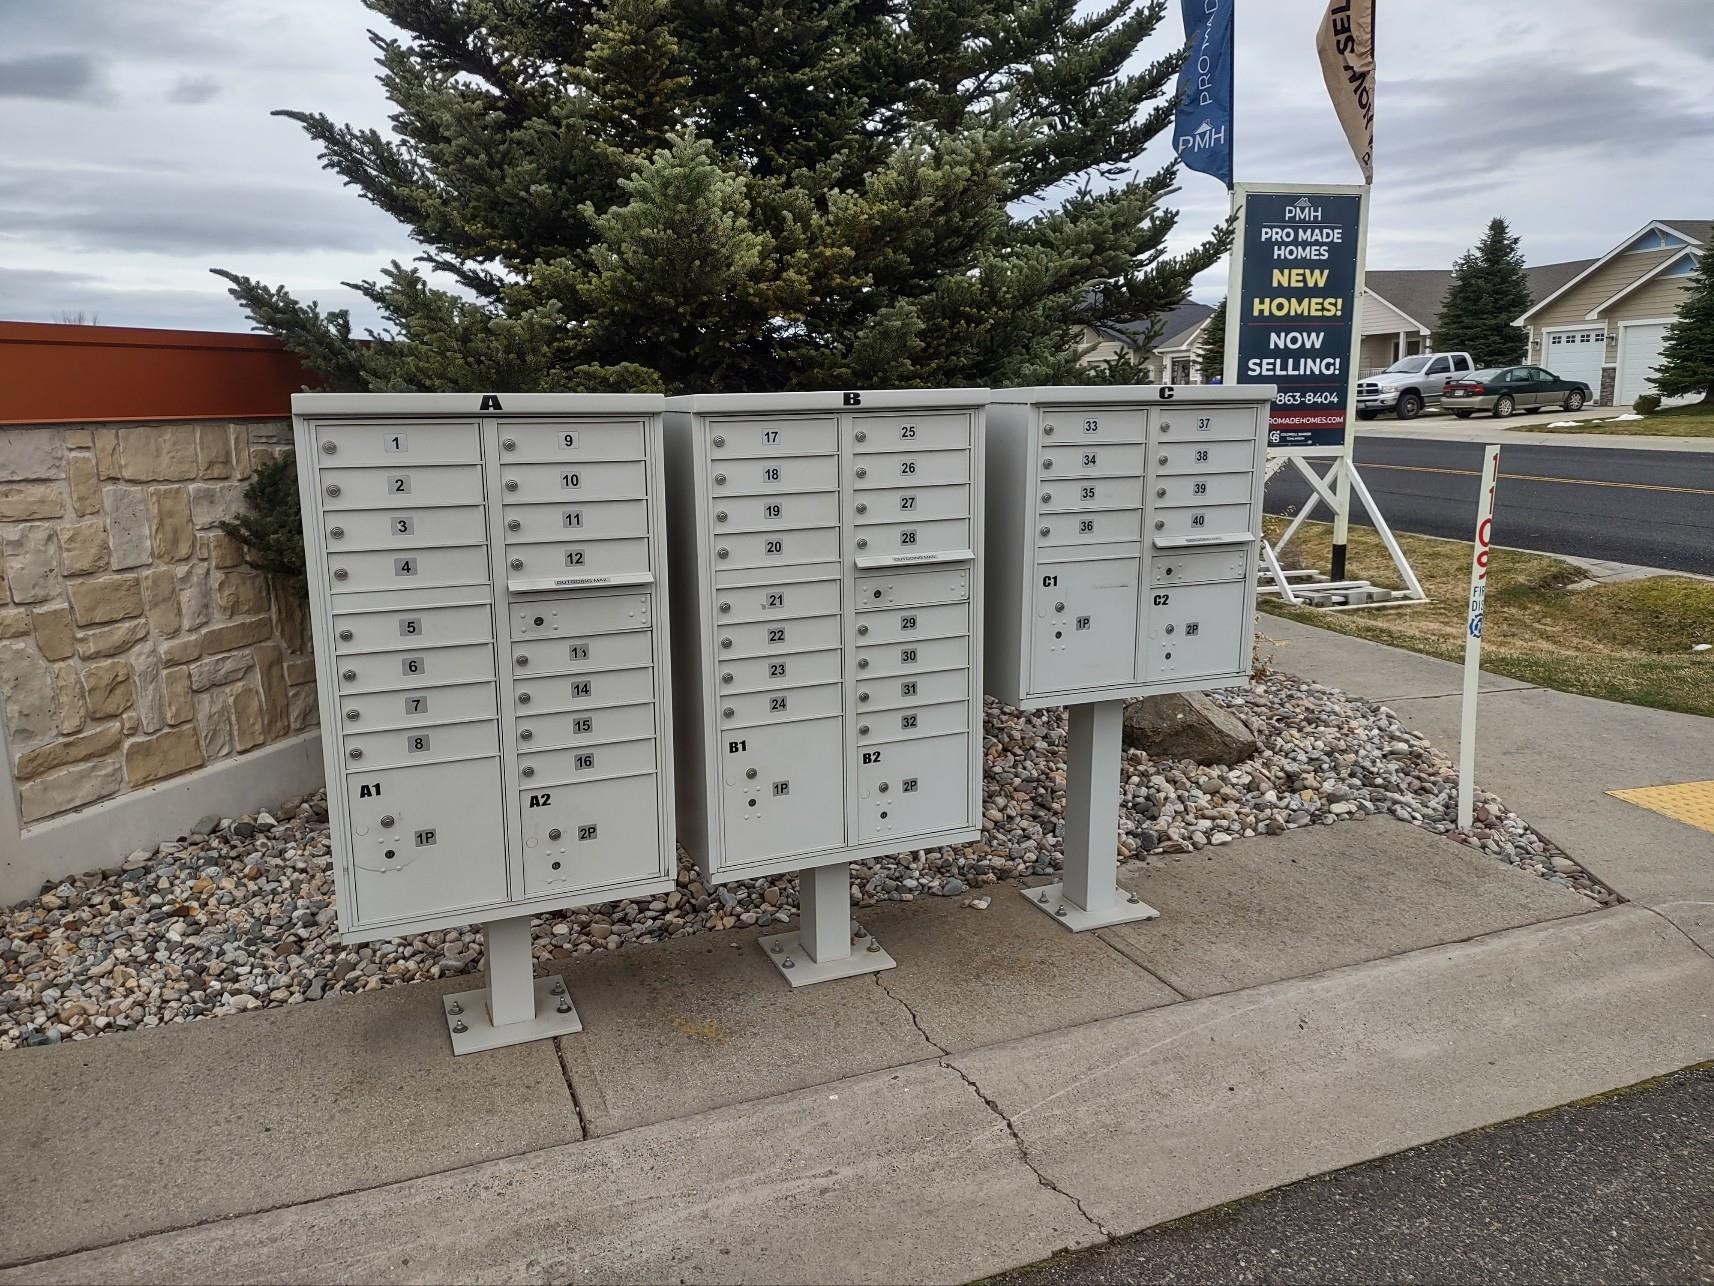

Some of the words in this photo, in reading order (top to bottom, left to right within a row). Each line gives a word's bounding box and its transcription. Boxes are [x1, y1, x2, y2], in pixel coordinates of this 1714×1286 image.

[1198, 55, 1212, 106] PRO
[1178, 125, 1225, 155] PMH
[1285, 206, 1322, 222] PMH
[1261, 228, 1294, 242] PRO
[1298, 228, 1342, 243] MADE
[1273, 246, 1329, 260] HOMES
[1272, 268, 1329, 288] NEW
[1253, 297, 1343, 317] HOMES!
[1269, 332, 1325, 350] NOW
[1247, 357, 1340, 376] SELLING!
[843, 391, 862, 406] B
[1158, 386, 1175, 400] C
[479, 394, 504, 411] A
[1085, 420, 1098, 432] 33
[1198, 418, 1211, 429] 37
[764, 431, 779, 443] 17
[901, 426, 916, 438] 25
[391, 436, 400, 450] 1
[564, 434, 573, 447] 9
[1083, 454, 1097, 466] 34
[1196, 450, 1208, 462] 38
[764, 468, 779, 481] 18
[901, 462, 916, 474] 26
[395, 478, 405, 492] 2
[562, 474, 579, 487] 10
[1082, 487, 1095, 499] 35
[1194, 483, 1206, 494] 39
[901, 497, 916, 509] 27
[766, 504, 780, 517] 19
[398, 519, 408, 533] 3
[565, 513, 580, 526] 11
[1080, 520, 1093, 532] 36
[1192, 515, 1205, 526] 40
[901, 532, 916, 544] 28
[767, 541, 782, 553] 20
[567, 552, 584, 565] 12
[401, 560, 412, 574] 4
[1042, 575, 1058, 588] C1
[769, 594, 783, 607] 21
[1153, 594, 1170, 606] C2
[407, 621, 416, 634] 5
[902, 617, 916, 629] 29
[1077, 618, 1090, 629] 1P
[1186, 624, 1199, 635] 2P
[769, 629, 785, 642] 22
[902, 650, 916, 662] 30
[408, 660, 418, 673] 6
[770, 664, 785, 676] 23
[573, 683, 590, 696] 14
[903, 683, 916, 695] 31
[411, 699, 421, 712] 7
[771, 697, 787, 711] 24
[575, 719, 591, 732] 15
[903, 716, 917, 728] 32
[414, 737, 424, 750] 8
[728, 739, 747, 754] B1
[576, 755, 592, 768] 16
[862, 750, 881, 765] B2
[359, 782, 382, 799] A1
[774, 782, 788, 795] 1P
[903, 780, 917, 792] 2P
[529, 793, 551, 809] A2
[416, 831, 435, 845] 1P
[579, 826, 596, 840] 2P
